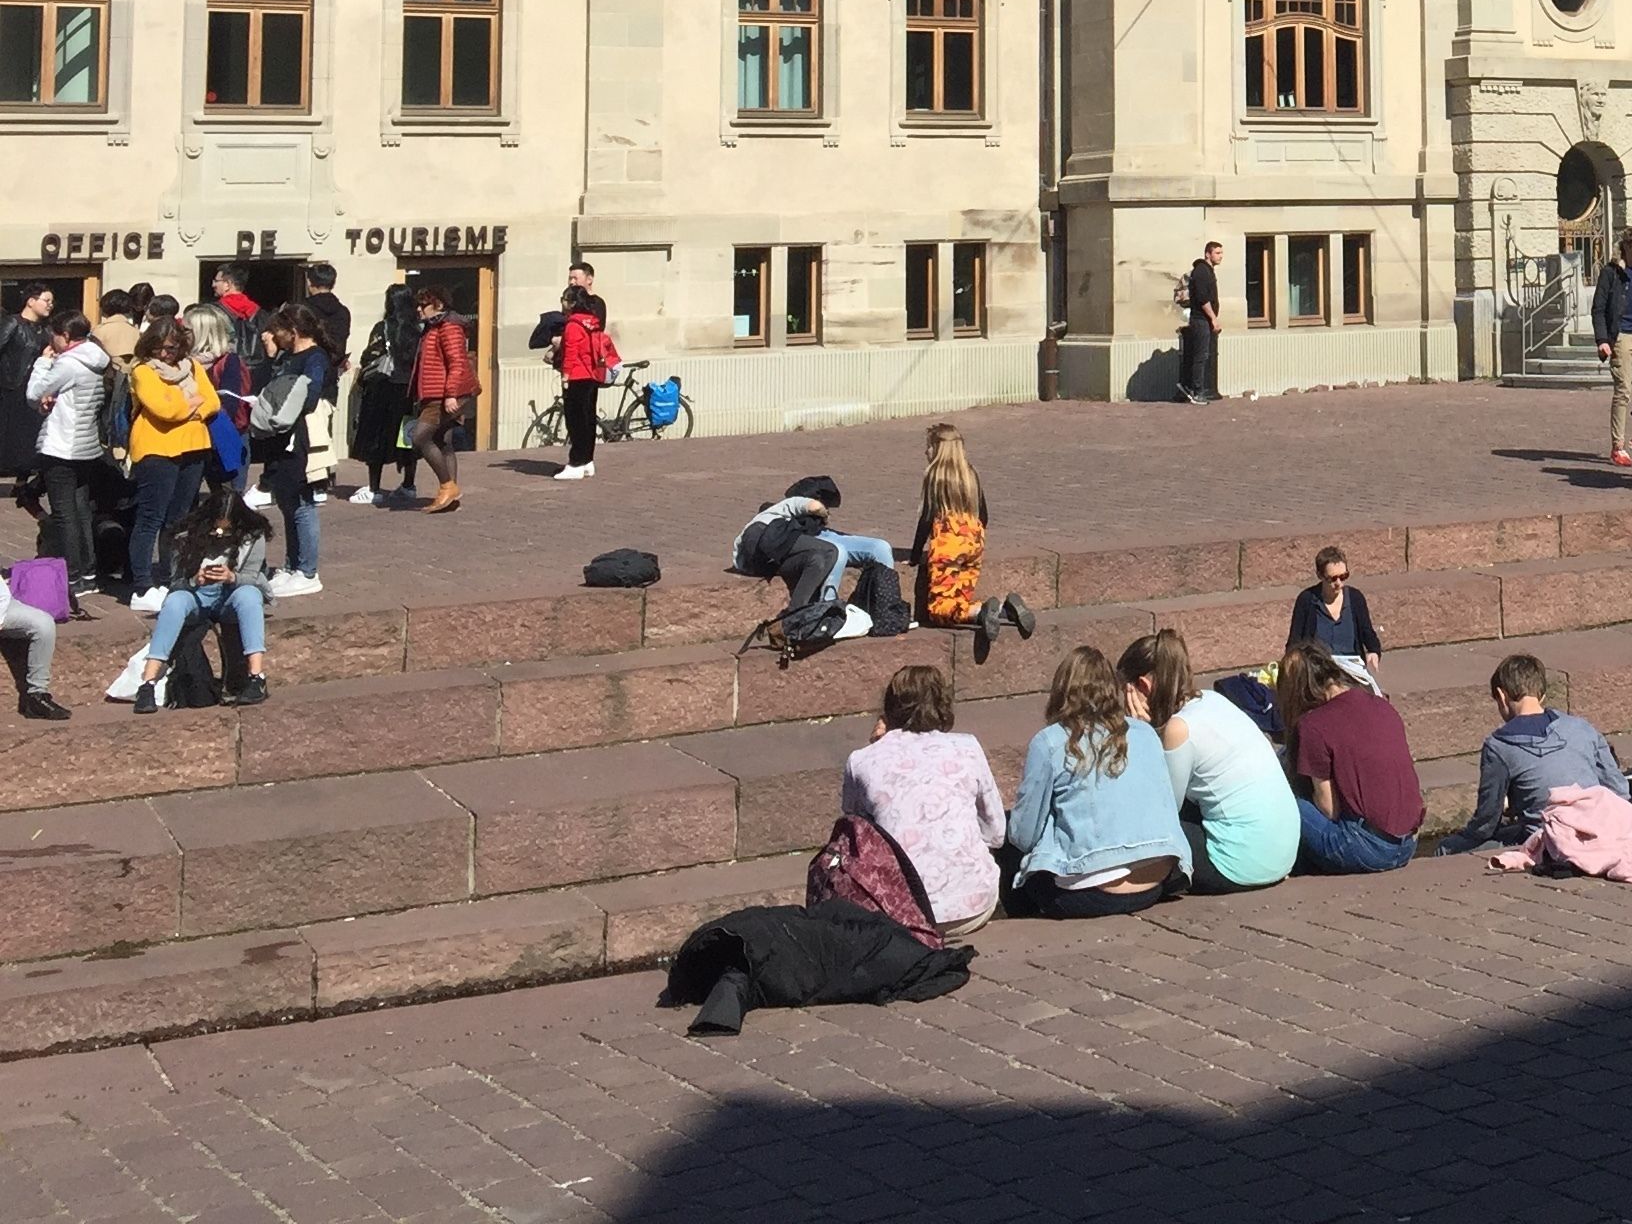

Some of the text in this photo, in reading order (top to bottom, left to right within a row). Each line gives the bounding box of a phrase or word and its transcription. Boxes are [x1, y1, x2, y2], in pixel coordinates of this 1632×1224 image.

[41, 226, 508, 261] OFFICE DE TOURISME
